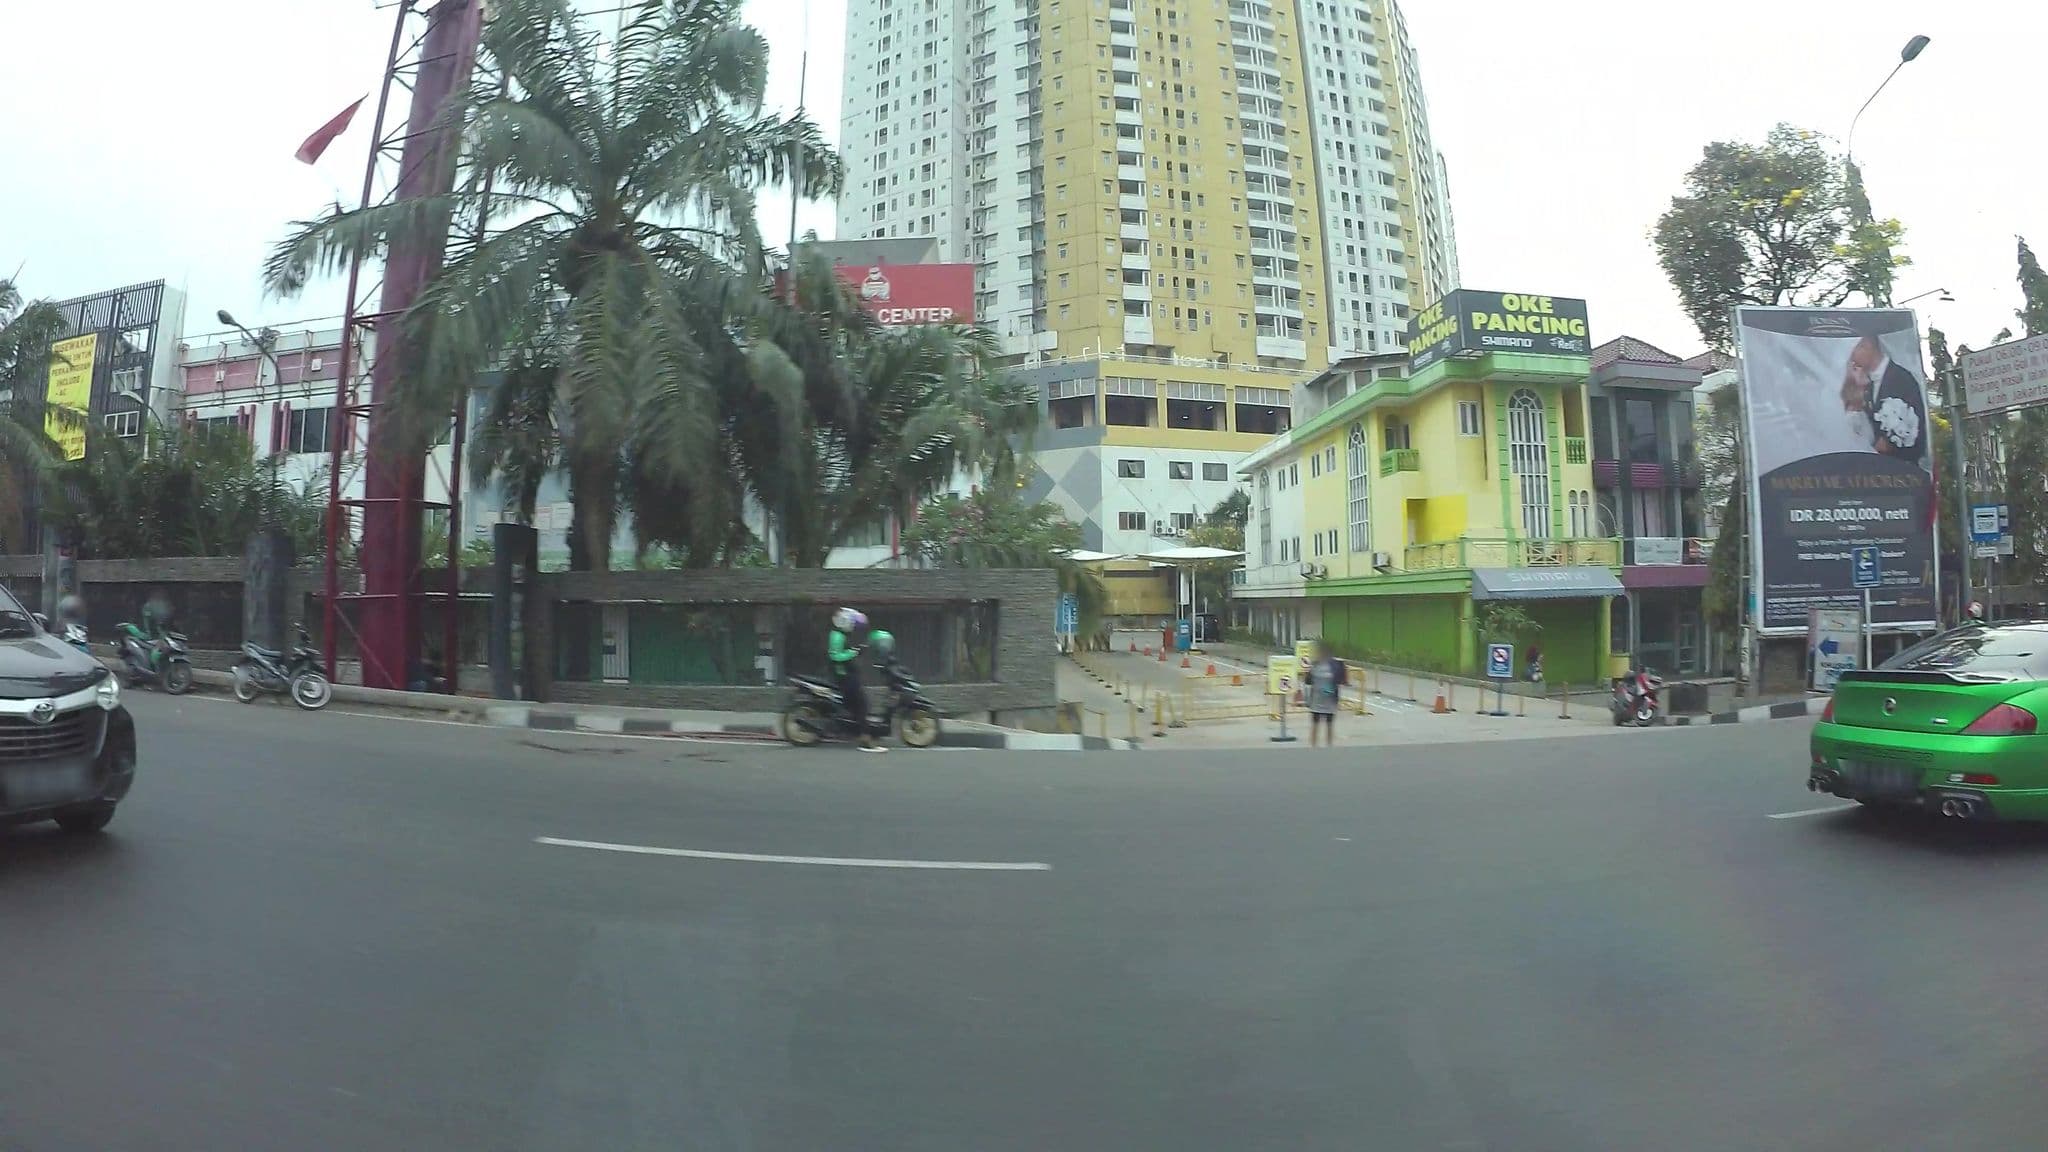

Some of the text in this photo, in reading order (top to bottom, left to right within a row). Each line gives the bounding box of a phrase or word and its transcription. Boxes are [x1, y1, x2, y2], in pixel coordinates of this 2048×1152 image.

[1502, 293, 1553, 313] OKE
[877, 307, 954, 324] CENTER
[1418, 302, 1443, 330] OKE
[1471, 312, 1586, 337] PANCING
[1409, 315, 1457, 356] PANCING
[1481, 336, 1531, 348] SHIMANO
[1790, 510, 1814, 522] IDR
[1885, 508, 1909, 520] nett
